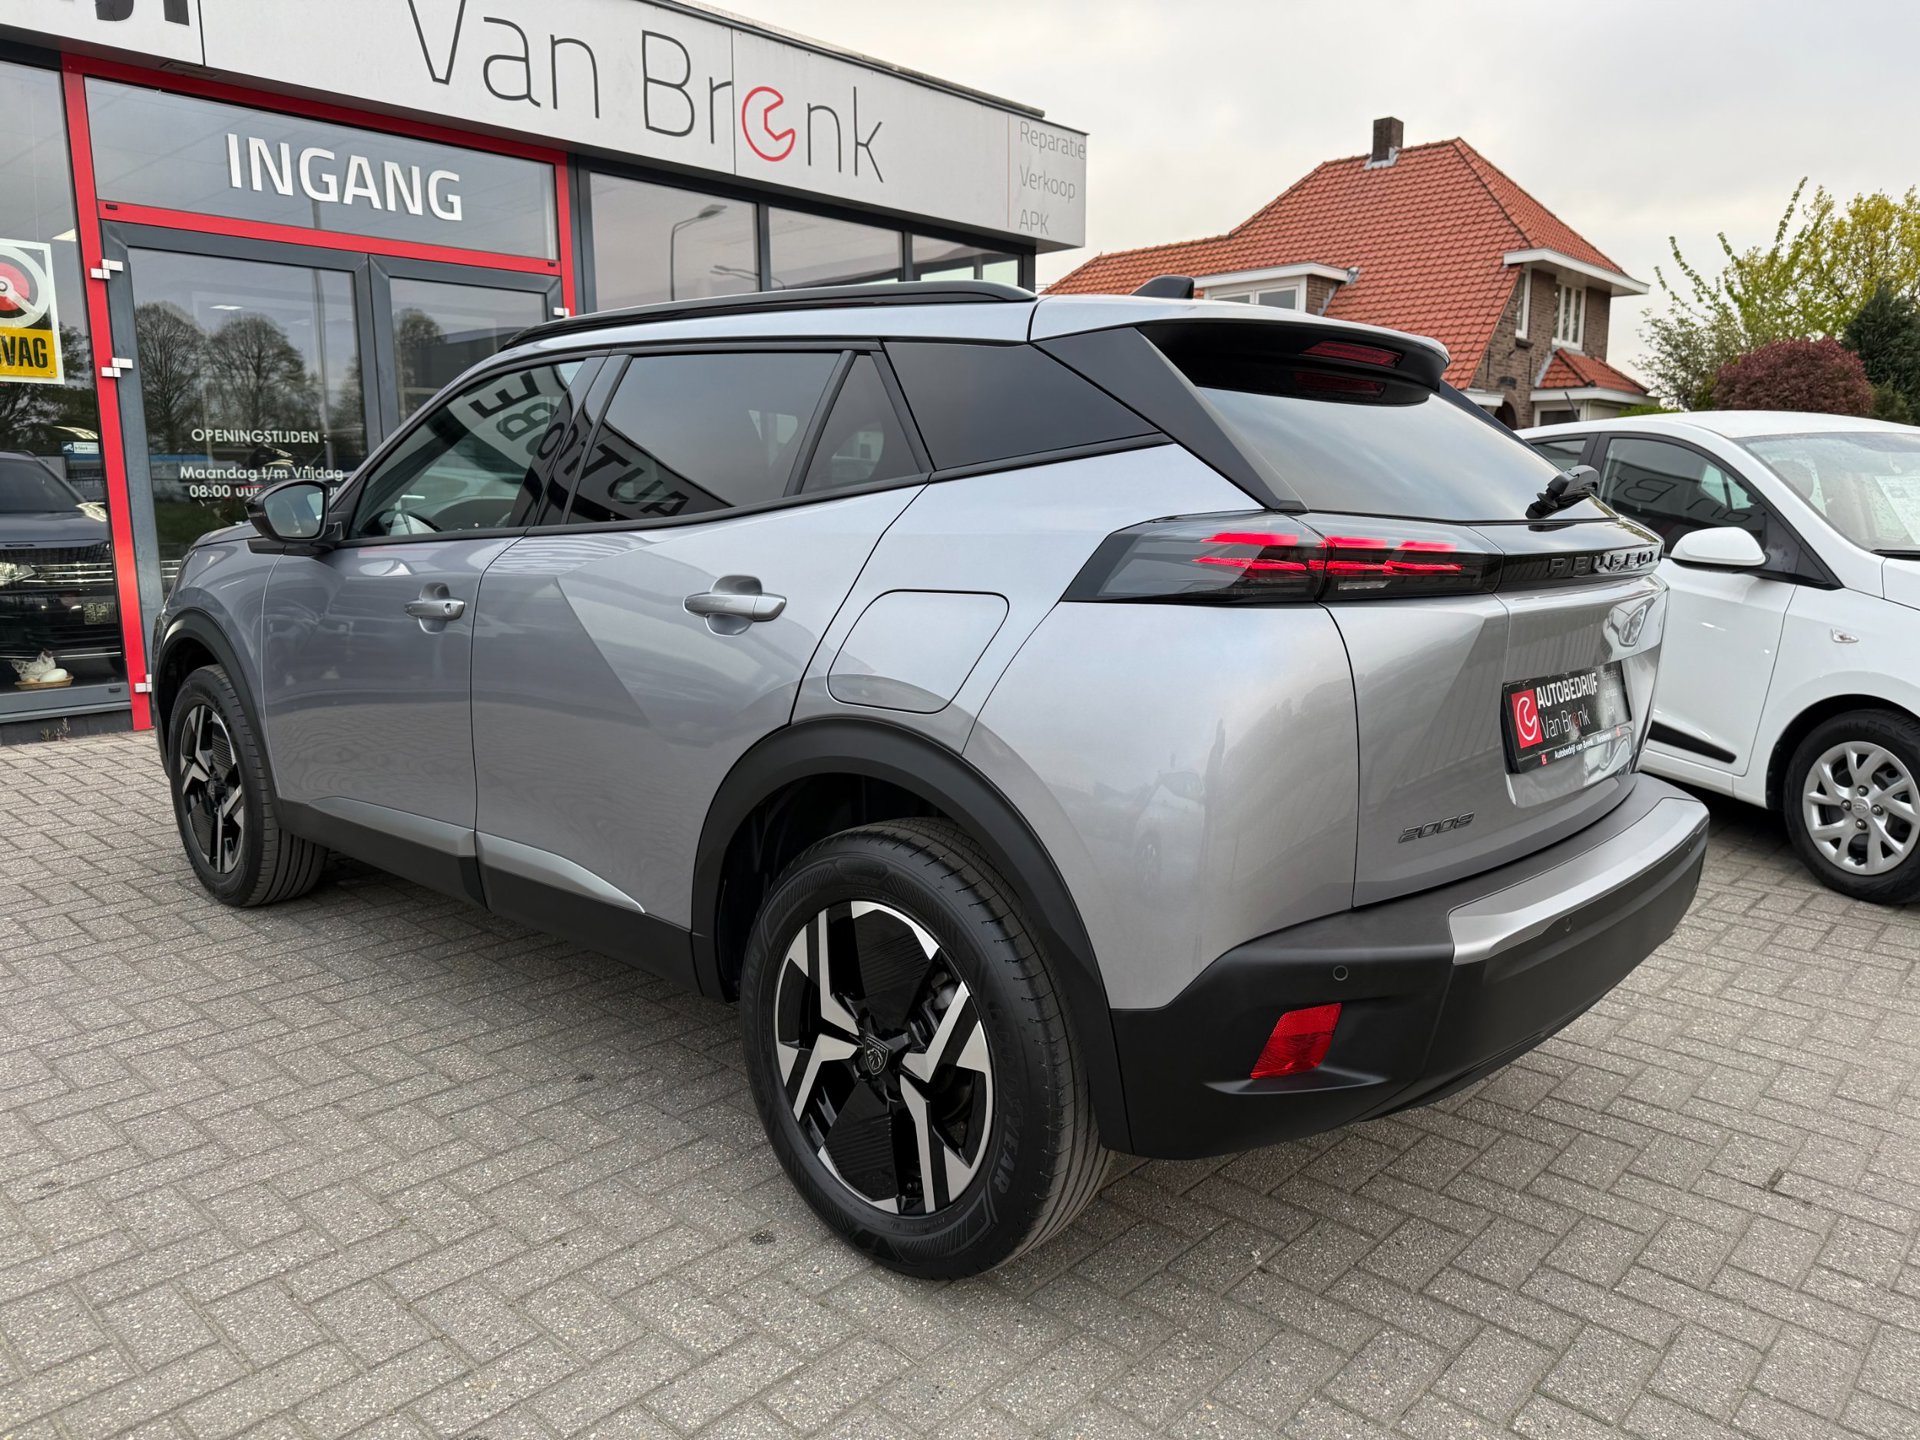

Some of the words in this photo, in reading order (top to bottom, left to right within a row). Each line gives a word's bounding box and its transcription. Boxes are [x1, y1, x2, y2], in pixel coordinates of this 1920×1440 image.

[409, 0, 600, 119] Van
[1020, 120, 1086, 160] Reparatie
[227, 133, 462, 221] INGANG
[1019, 164, 1076, 204] Verkoop
[1019, 208, 1049, 235] APK
[191, 428, 319, 444] OPENINGSTIJDEN
[180, 466, 257, 481] Maandag
[262, 466, 288, 480] t/m
[292, 466, 343, 481] Vrijdag
[189, 485, 231, 498] 08:00
[1547, 550, 1655, 576] PEUGEOT
[1536, 672, 1598, 709] AUTOBEDRIJF
[1540, 712, 1563, 739] Van
